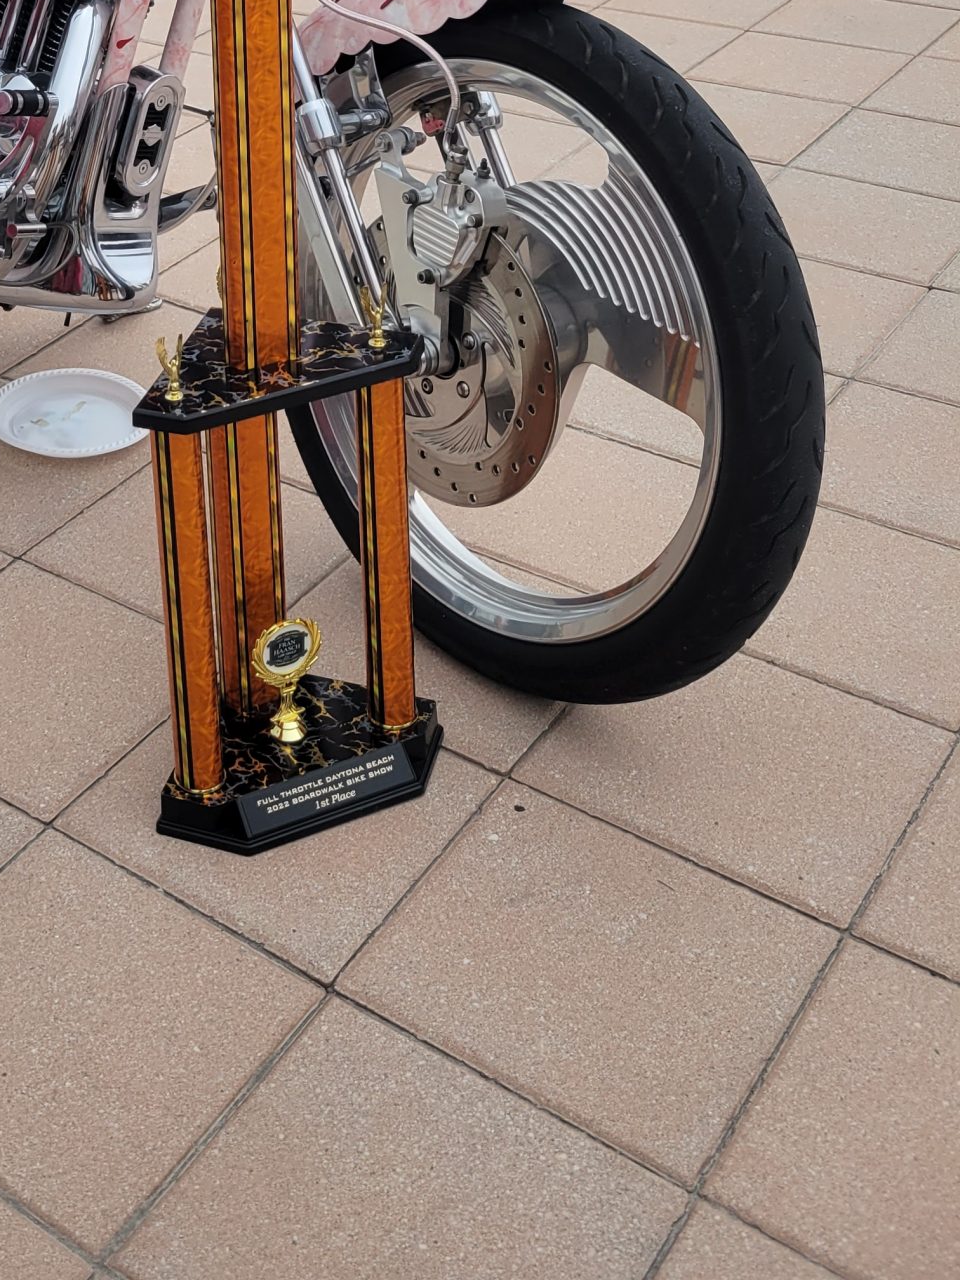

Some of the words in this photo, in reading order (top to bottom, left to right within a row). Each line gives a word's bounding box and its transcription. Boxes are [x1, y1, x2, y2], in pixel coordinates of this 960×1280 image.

[278, 639, 296, 649] FRAN
[256, 795, 279, 807] FULL
[280, 779, 324, 798] THROTTLE
[325, 765, 365, 783] DAYTONA
[365, 754, 395, 769] BEACH
[266, 801, 290, 814] 2022
[292, 782, 344, 805] BOARDWALK
[346, 774, 366, 786] BIKE
[368, 765, 393, 778] SHOW
[315, 798, 330, 810] 1st
[331, 790, 356, 804] Place
